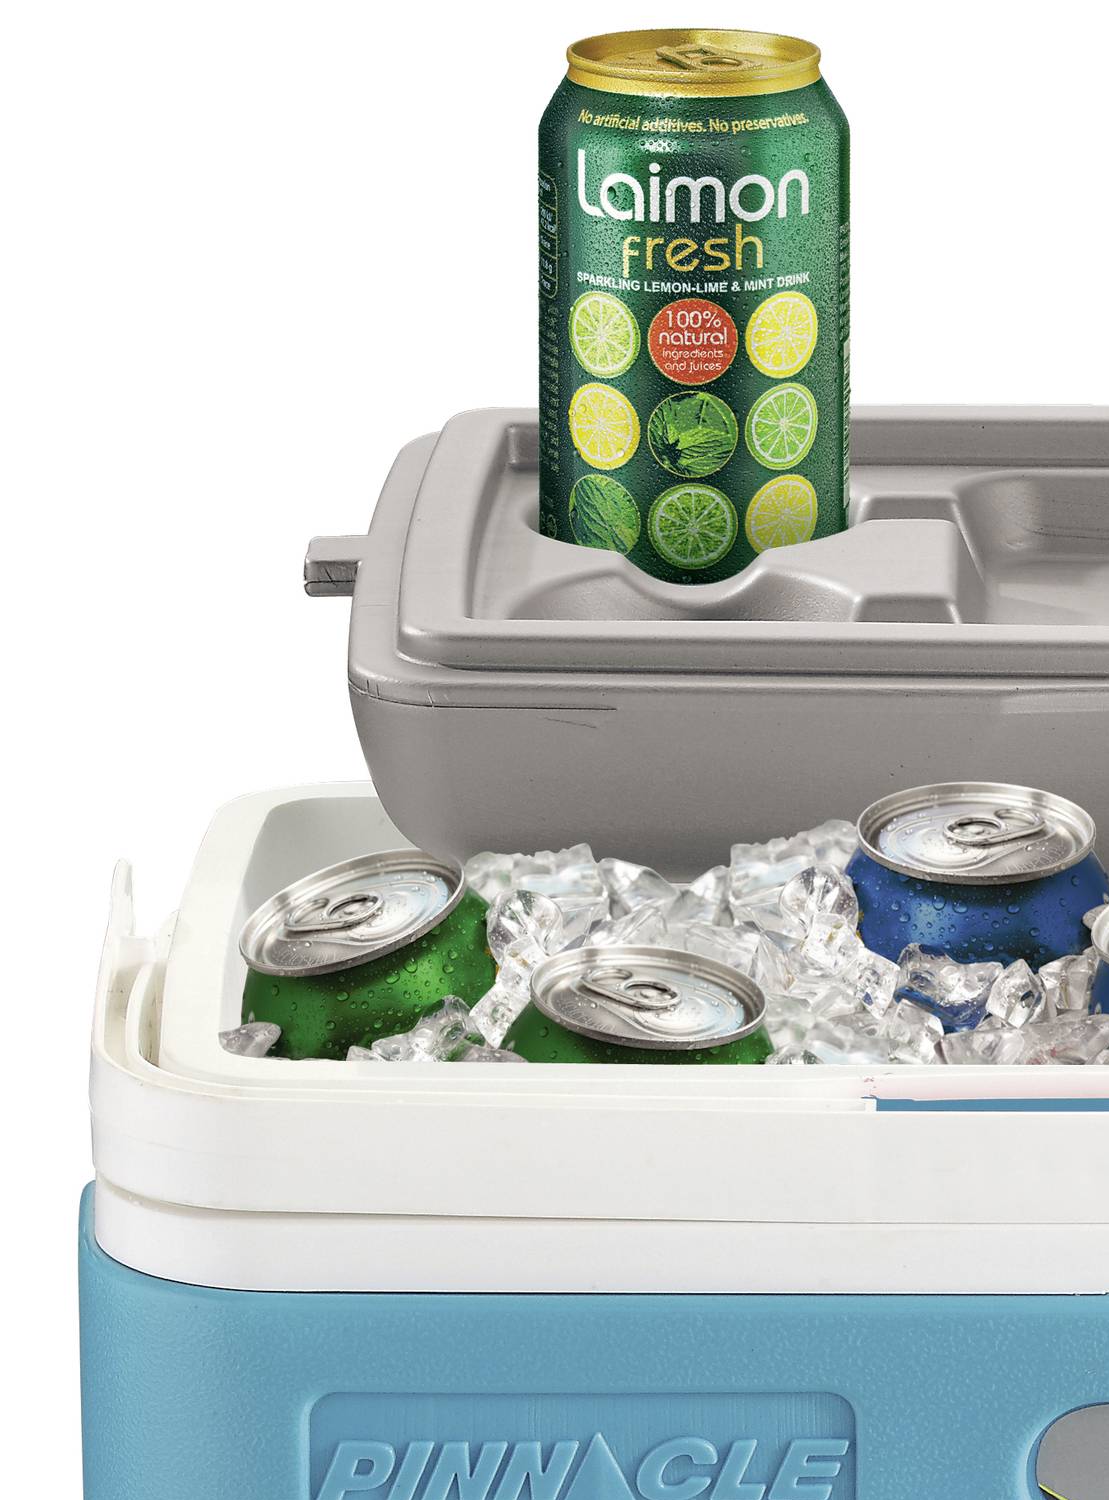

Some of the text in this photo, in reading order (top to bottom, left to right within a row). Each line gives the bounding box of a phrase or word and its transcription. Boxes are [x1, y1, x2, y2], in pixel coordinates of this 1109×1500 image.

[578, 109, 809, 134] No artificial additives. No preservatives.
[622, 224, 763, 278] fresh
[577, 271, 810, 293] SPARKLING LEMON-LIME & MINT DRINK
[666, 310, 721, 328] 100%
[659, 327, 728, 345] natural
[662, 348, 724, 360] ingredients
[665, 361, 722, 373] and juices
